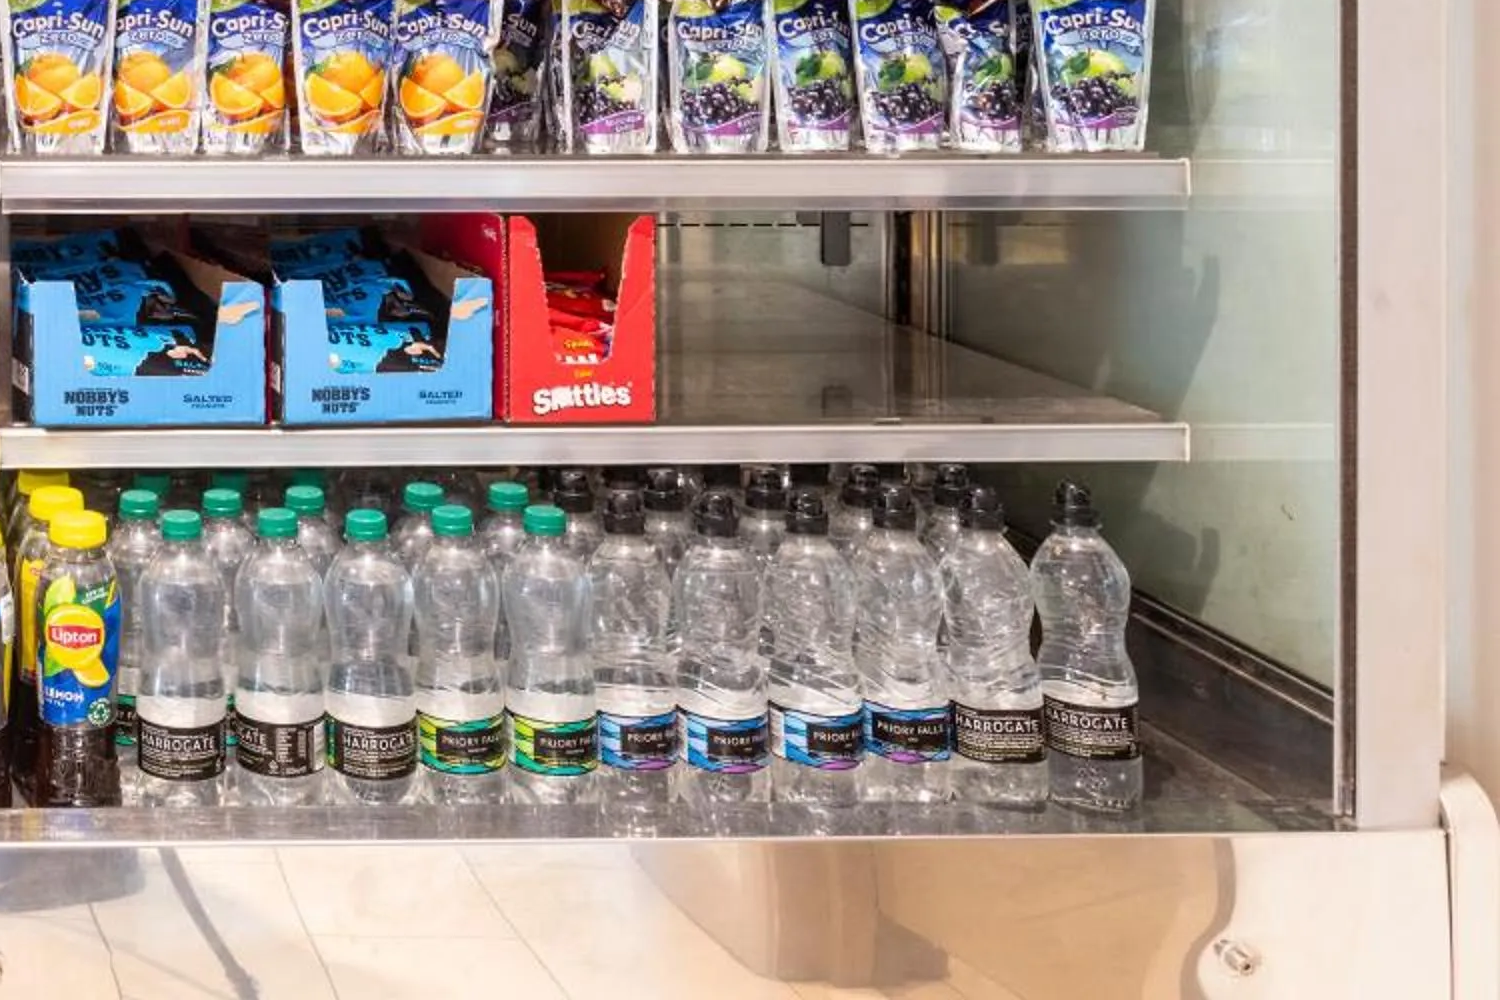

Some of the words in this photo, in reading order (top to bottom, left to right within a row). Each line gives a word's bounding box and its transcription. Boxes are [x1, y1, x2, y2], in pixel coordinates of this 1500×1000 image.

[13, 12, 105, 40] Capri-Sun
[303, 10, 389, 38] Capri-Sun
[398, 12, 487, 40] Capri-Sun
[678, 18, 763, 41] Capri-Sun
[64, 390, 130, 404] NOBBY'S
[183, 394, 233, 404] SALTED
[312, 387, 370, 402] NOBBY'S
[419, 390, 463, 400] SALTED
[534, 383, 632, 415] Skittles
[75, 405, 113, 417] NUTS
[322, 402, 355, 414] NUTS
[51, 628, 98, 644] Lipton
[44, 686, 84, 702] LEMON
[957, 716, 1040, 733] HARROGATE
[1047, 710, 1129, 731] HARROGATE
[877, 722, 915, 736] PRIORY
[917, 722, 944, 736] FALLS
[141, 732, 217, 750] HARROGATE
[343, 733, 414, 751] HARROGATE
[440, 734, 480, 748] PRIORY
[540, 736, 578, 749] PRIORY
[627, 732, 663, 744] PRIORY
[713, 734, 750, 746] PRIORY
[813, 732, 851, 744] PRIORY
